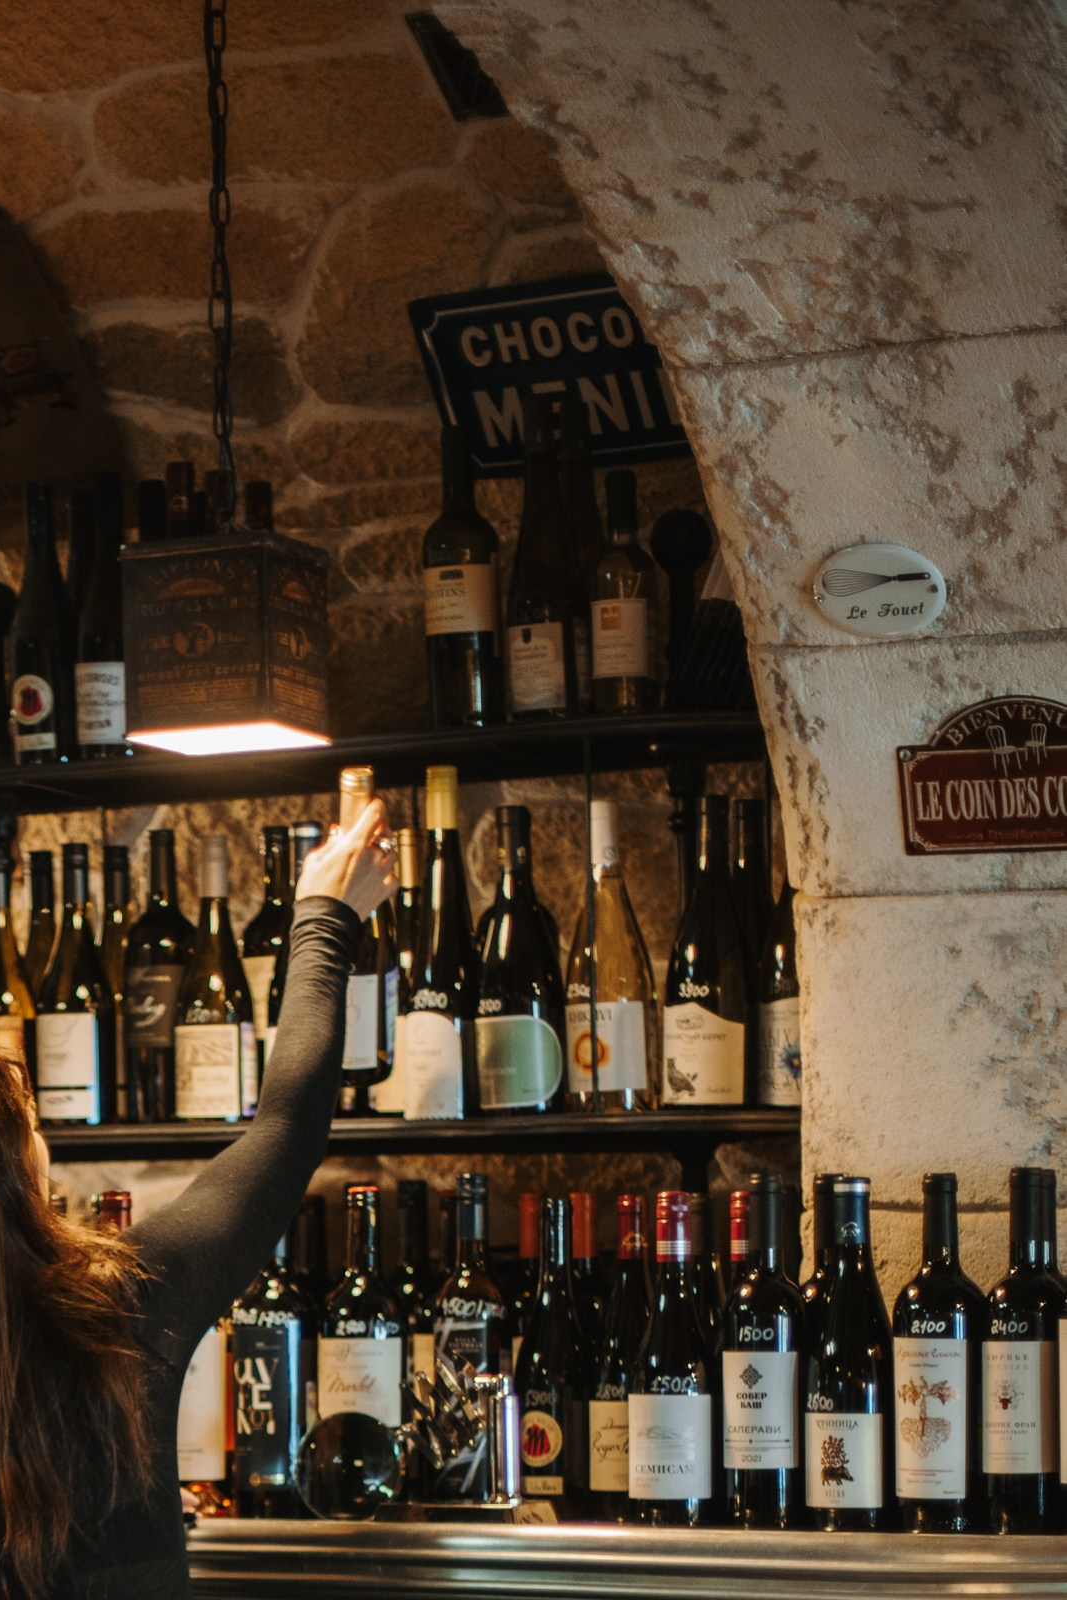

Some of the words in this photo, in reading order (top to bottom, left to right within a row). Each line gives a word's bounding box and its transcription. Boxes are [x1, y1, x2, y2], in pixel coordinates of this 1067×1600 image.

[472, 368, 682, 447] MNI
[847, 606, 867, 619] Le
[878, 602, 924, 617] Fouet
[914, 781, 943, 821] LE
[945, 779, 997, 820] COIN
[999, 776, 1040, 818] DES
[739, 1326, 774, 1342] 1500
[911, 1320, 946, 1334] 2100
[991, 1319, 1028, 1335] 2400
[651, 1376, 694, 1392] 1500
[736, 1392, 767, 1400] СОБЕР
[728, 1425, 781, 1434] САПЕРАВИ
[741, 1454, 762, 1463] 2021
